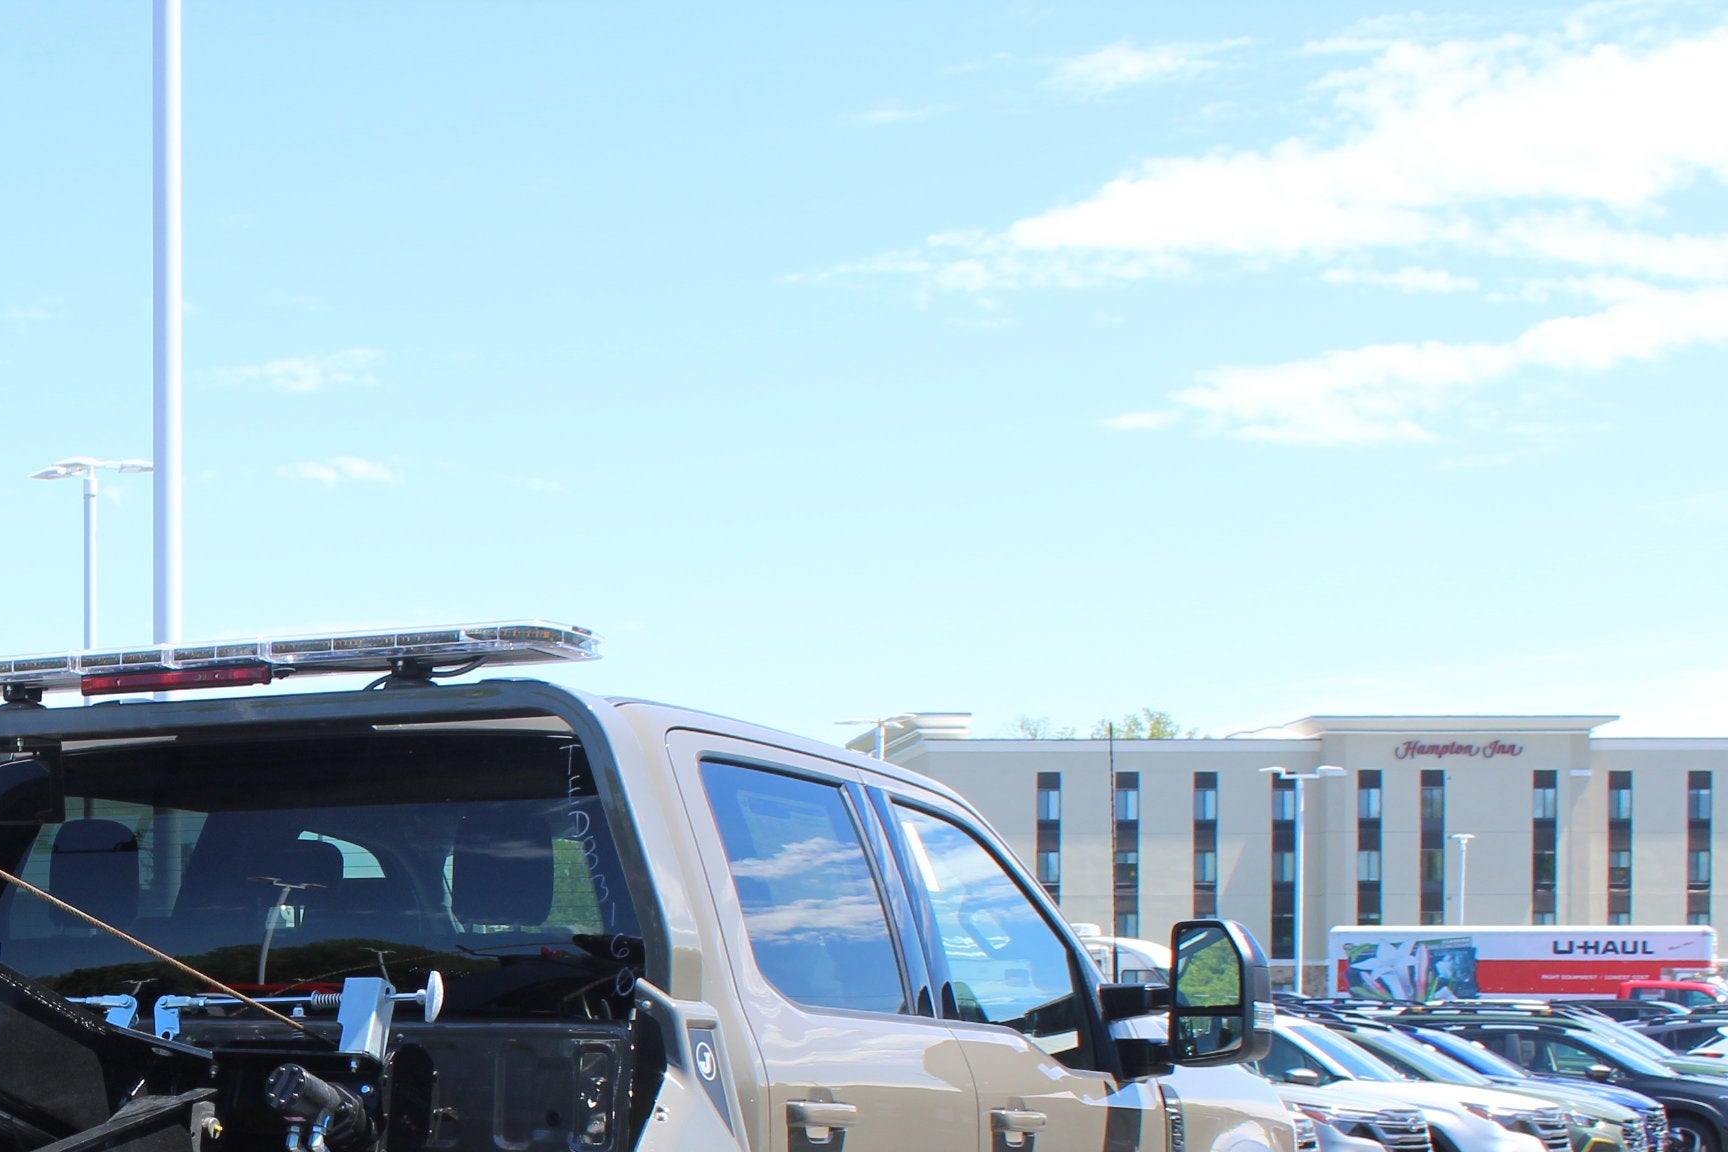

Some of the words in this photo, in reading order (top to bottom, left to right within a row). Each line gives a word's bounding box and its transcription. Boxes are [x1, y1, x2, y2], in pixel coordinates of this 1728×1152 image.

[1394, 740, 1480, 759] Hampton
[1482, 739, 1523, 759] Inn
[1552, 940, 1655, 955] U-HAUL
